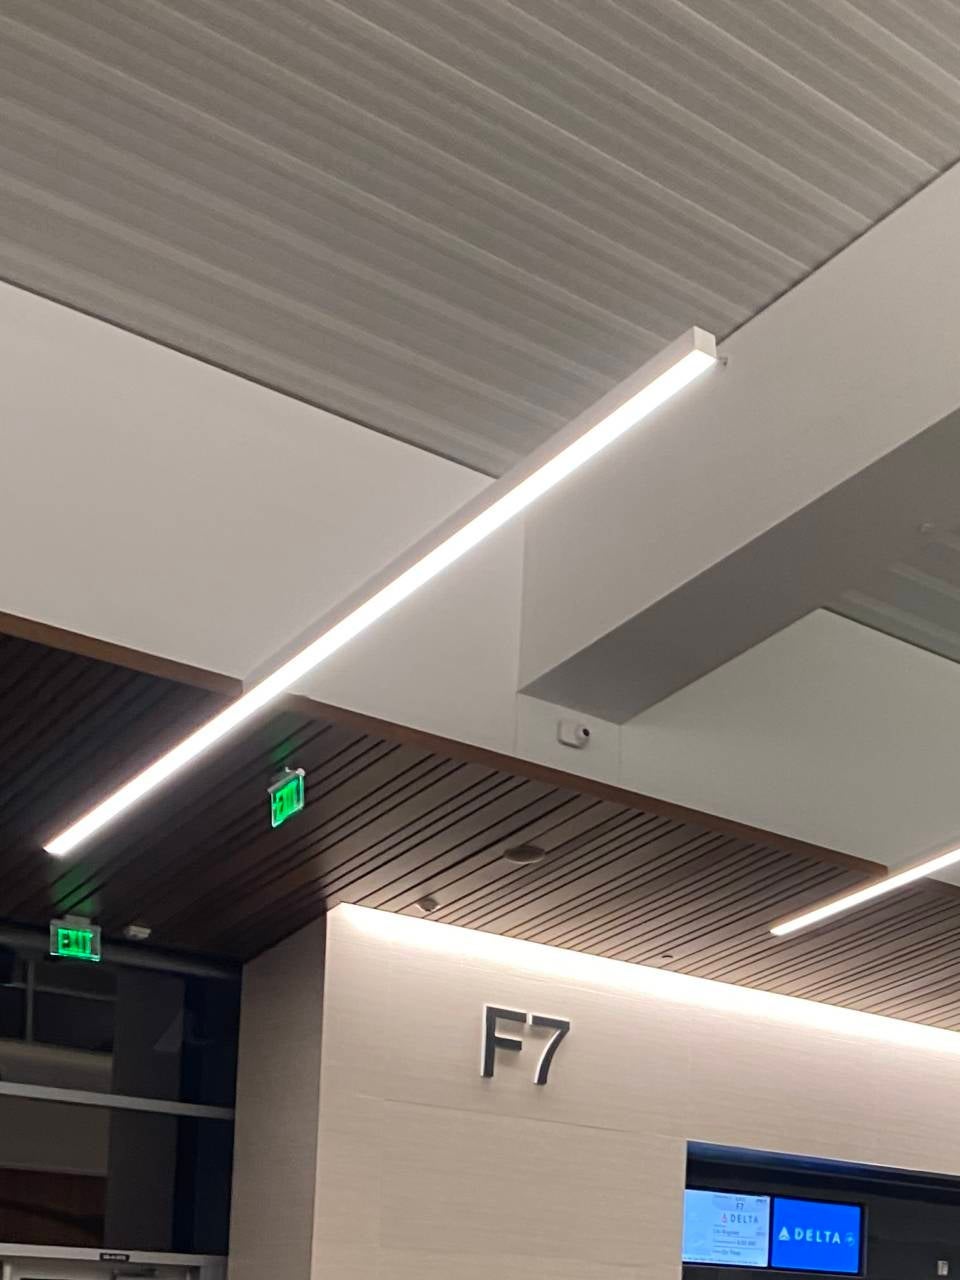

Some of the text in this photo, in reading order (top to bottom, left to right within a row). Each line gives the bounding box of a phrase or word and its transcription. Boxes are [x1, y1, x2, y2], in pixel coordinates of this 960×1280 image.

[58, 928, 94, 955] EXIT
[481, 1004, 570, 1085] F7
[730, 1214, 760, 1225] DELTA
[794, 1227, 841, 1245] DELTA
